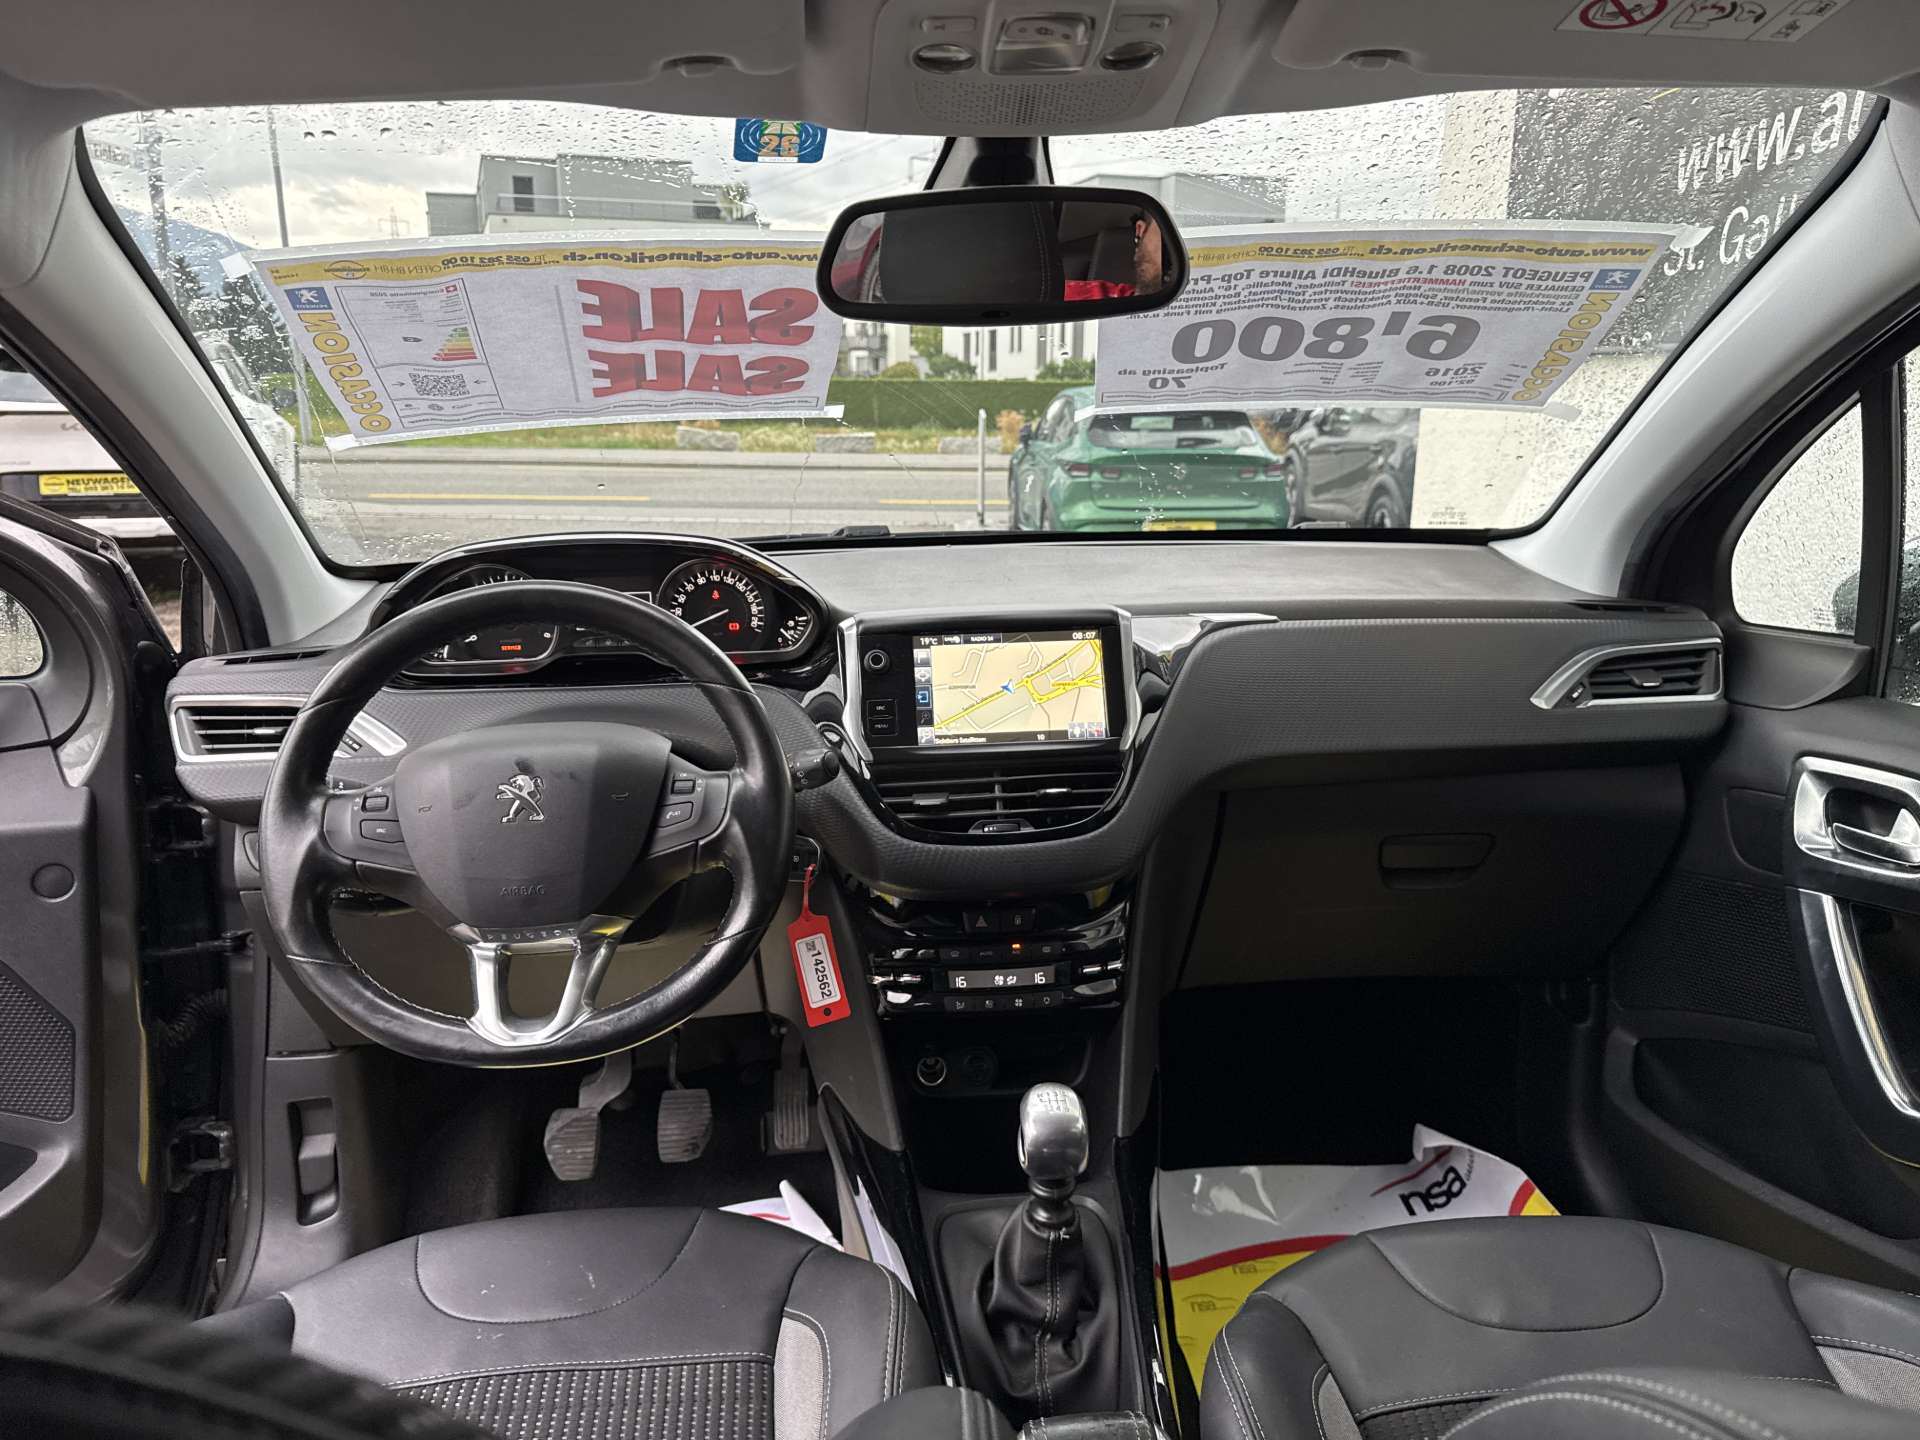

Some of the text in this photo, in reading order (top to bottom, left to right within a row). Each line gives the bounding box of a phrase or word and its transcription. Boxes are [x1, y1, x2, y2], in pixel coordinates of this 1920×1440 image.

[1072, 632, 1096, 640] 08:07
[499, 884, 546, 897] AIRBAG
[811, 950, 832, 998] 142562
[955, 971, 1046, 988] 16 16
[1398, 1165, 1468, 1217] nsa
[1190, 1300, 1217, 1313] nsa
